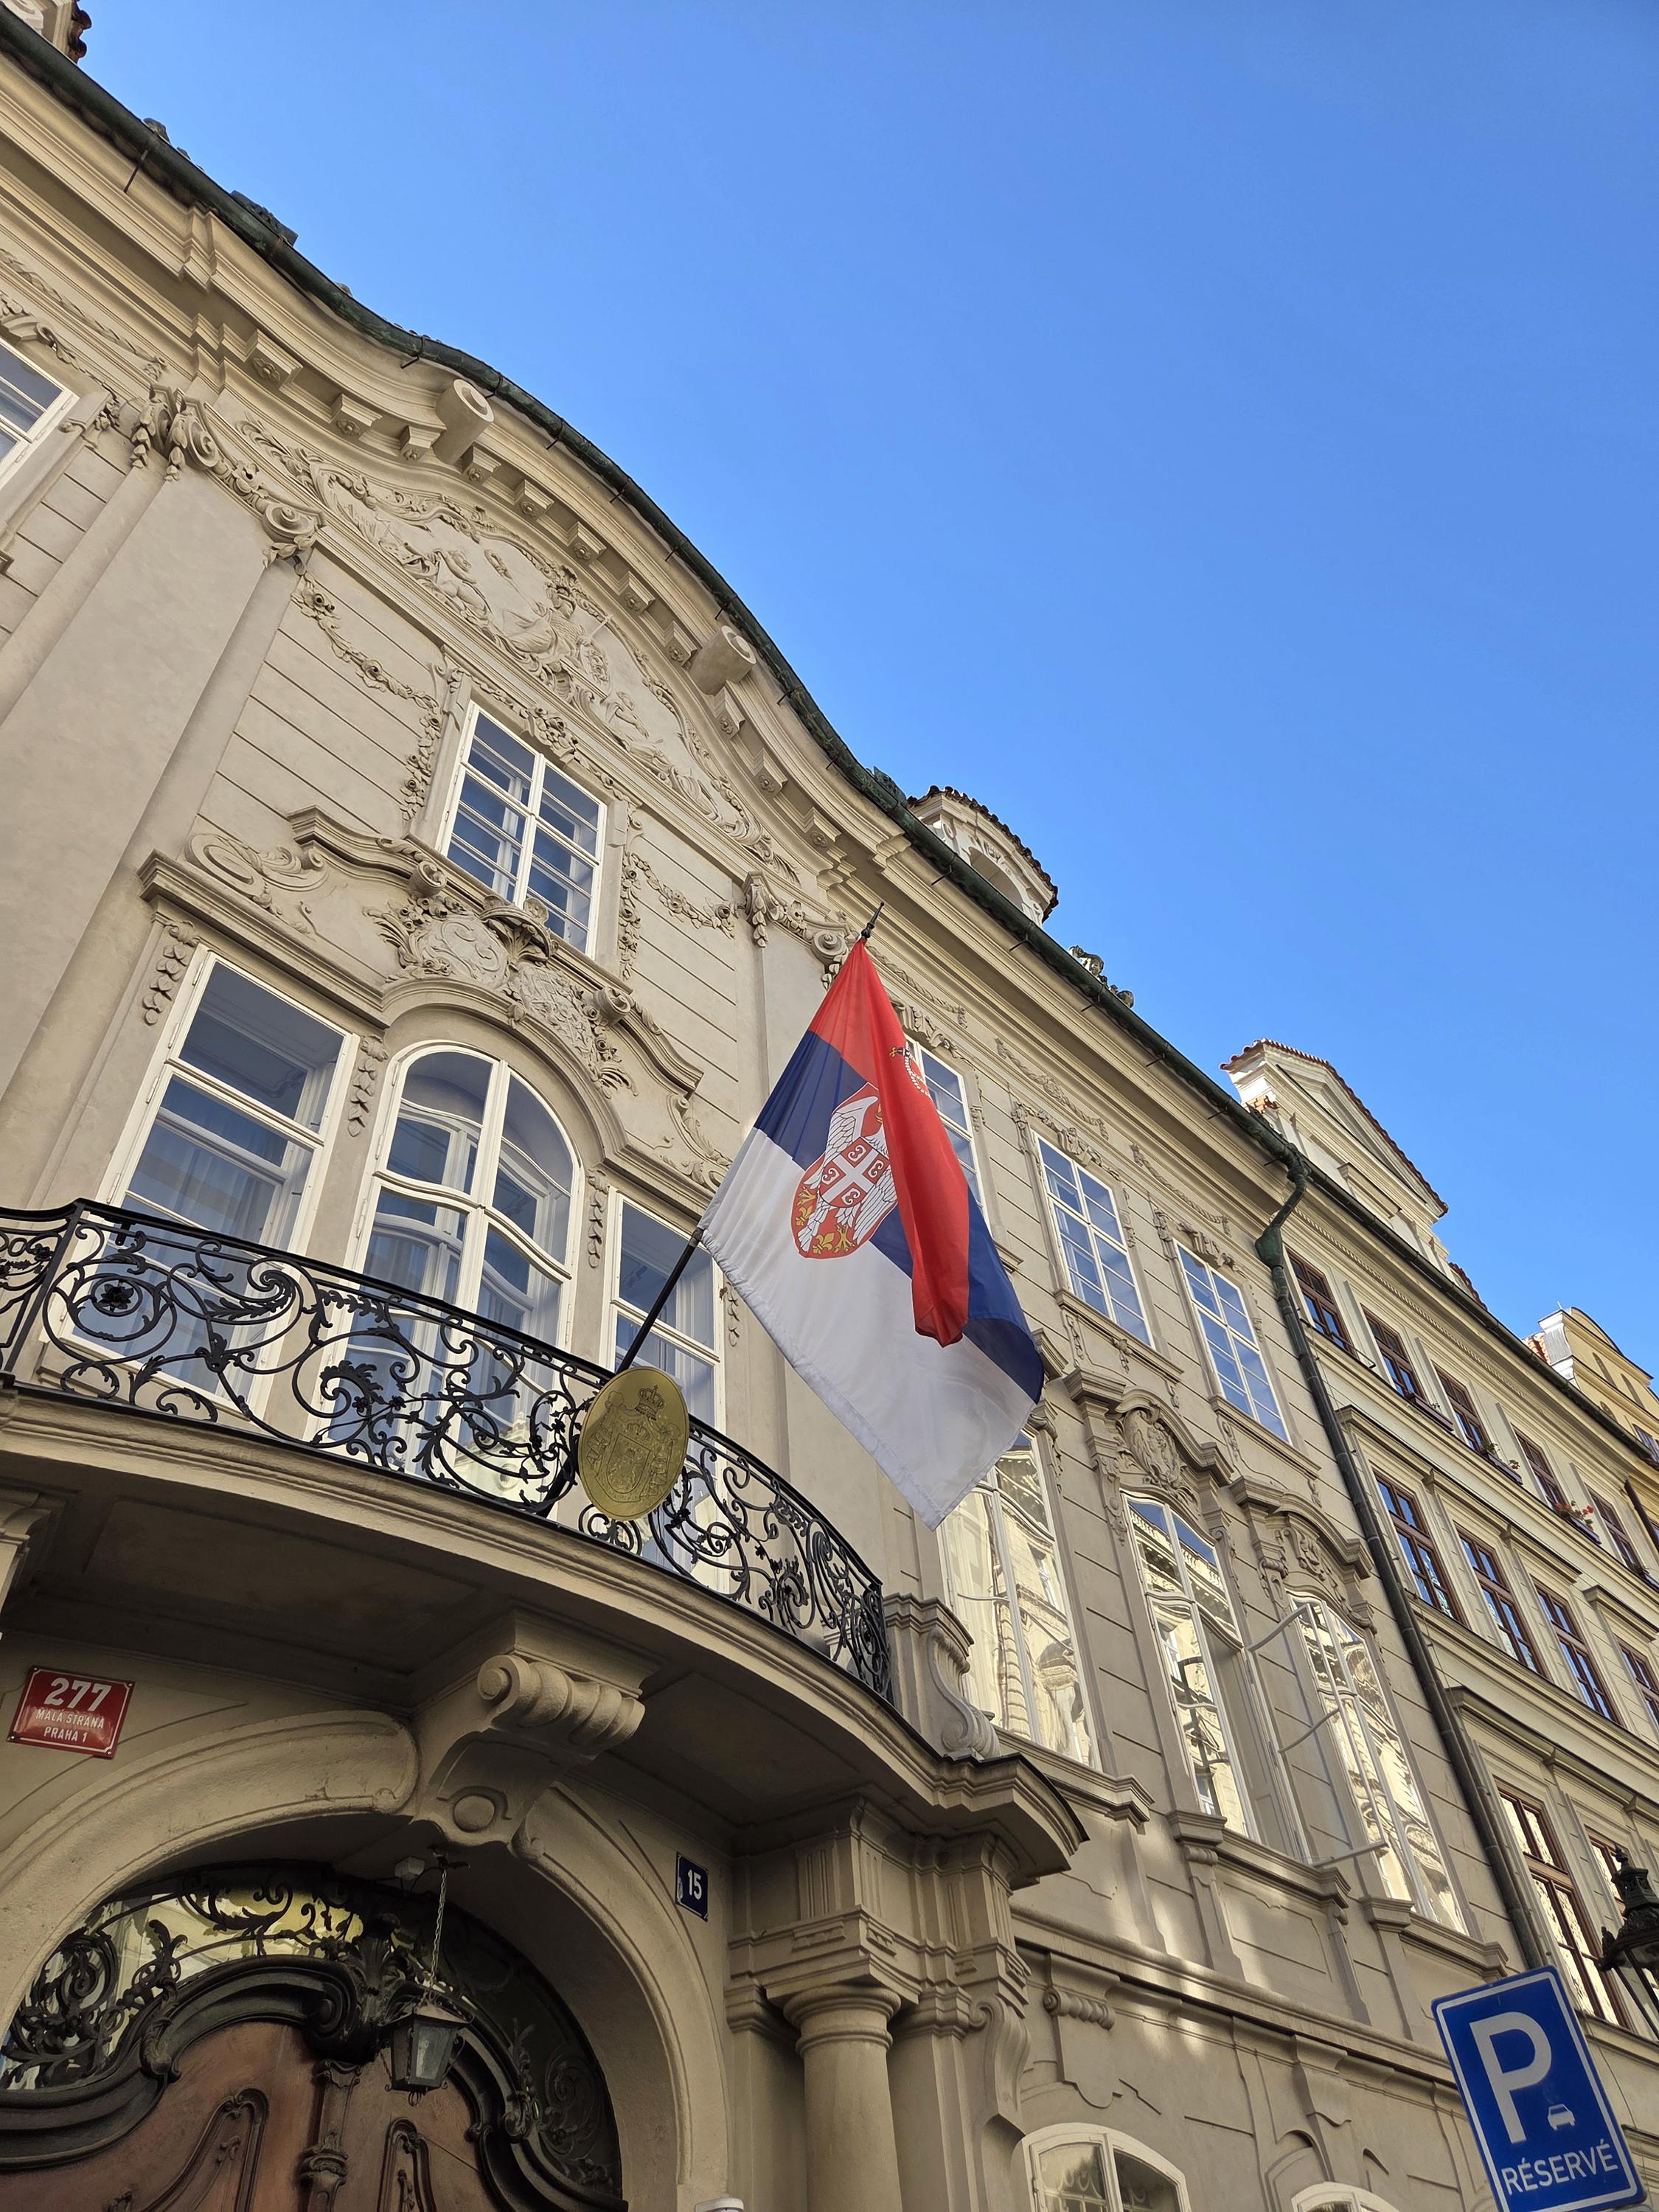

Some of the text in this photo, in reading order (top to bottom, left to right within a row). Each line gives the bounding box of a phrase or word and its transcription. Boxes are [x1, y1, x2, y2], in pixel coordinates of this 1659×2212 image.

[44, 1677, 112, 1711] 277
[35, 1709, 105, 1729] MALÁ STRANA
[44, 1726, 88, 1742] PRAHA 1
[687, 1869, 702, 1900] 15
[1469, 2011, 1552, 2144] P
[1501, 2138, 1618, 2195] RÉSERVÉ
